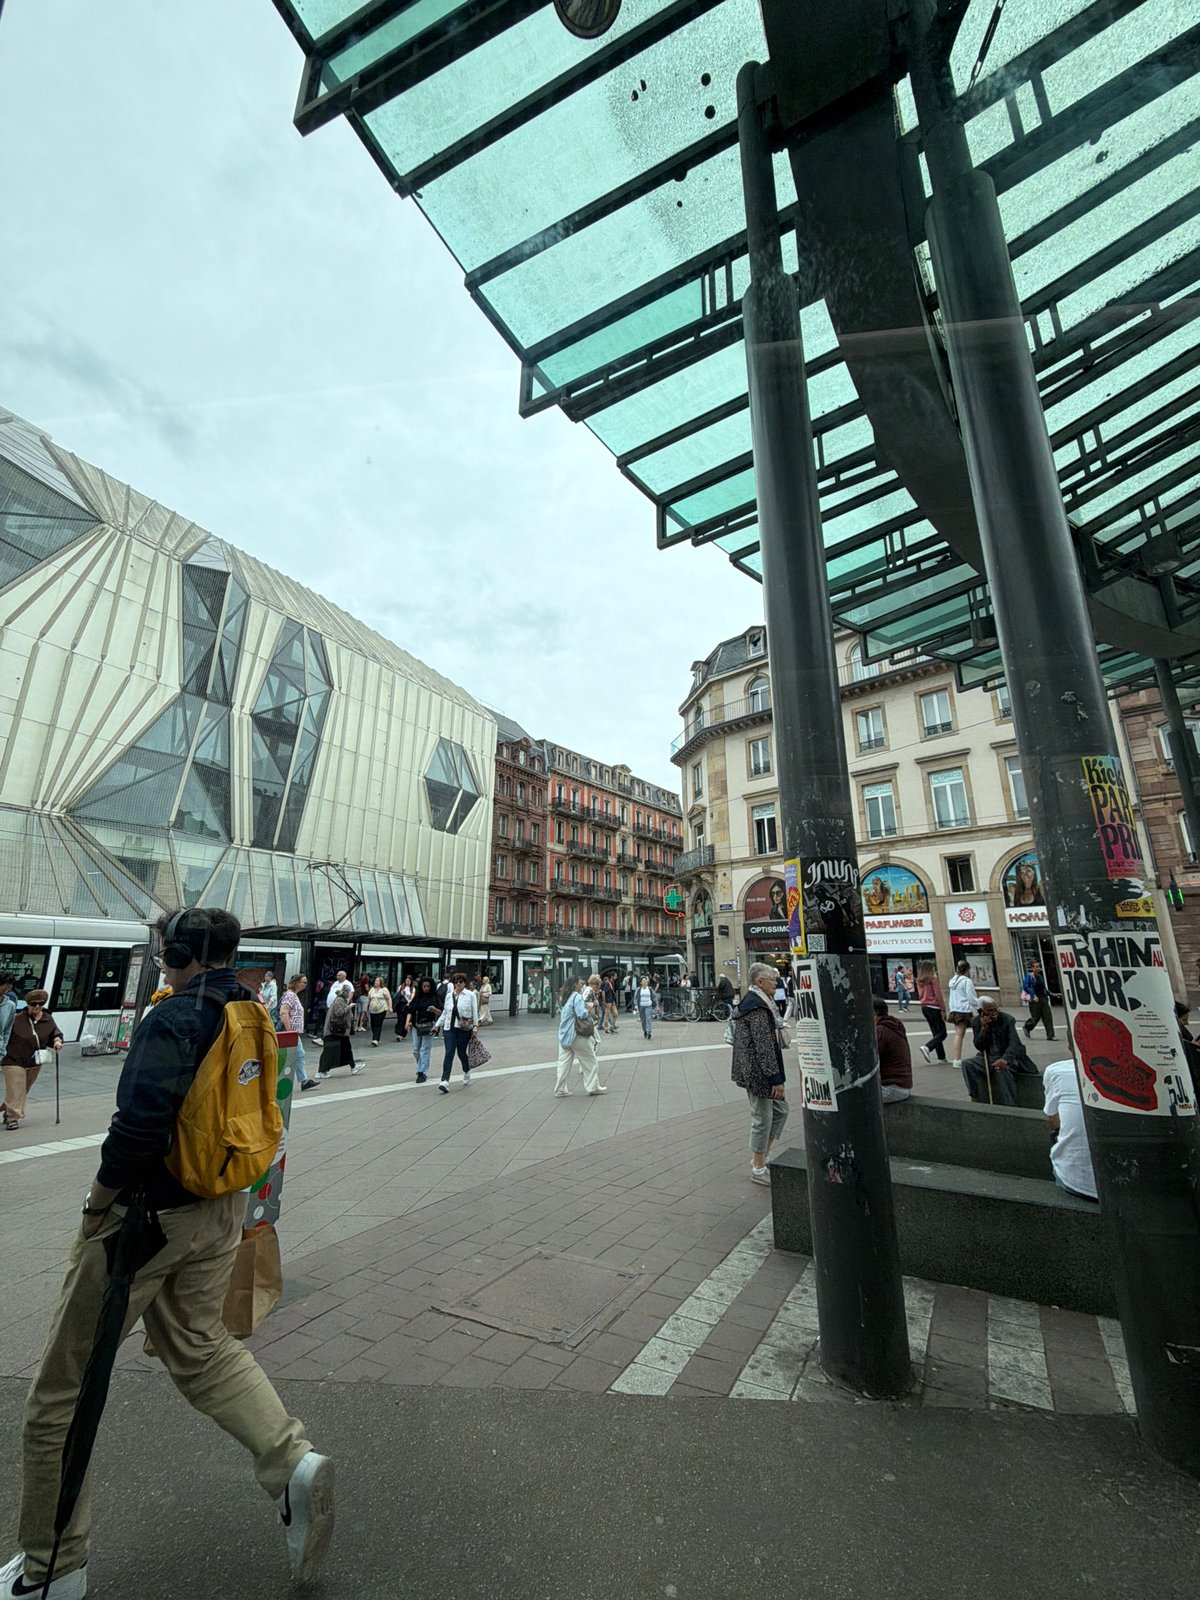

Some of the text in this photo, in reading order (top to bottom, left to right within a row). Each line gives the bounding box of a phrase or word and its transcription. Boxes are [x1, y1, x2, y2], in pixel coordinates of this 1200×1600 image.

[865, 918, 924, 929] PARFUMERIE
[873, 938, 899, 946] BEAUTY
[1059, 951, 1076, 968] DU
[1153, 950, 1164, 967] AU
[800, 974, 812, 990] AU
[809, 1076, 832, 1101] JUIN
